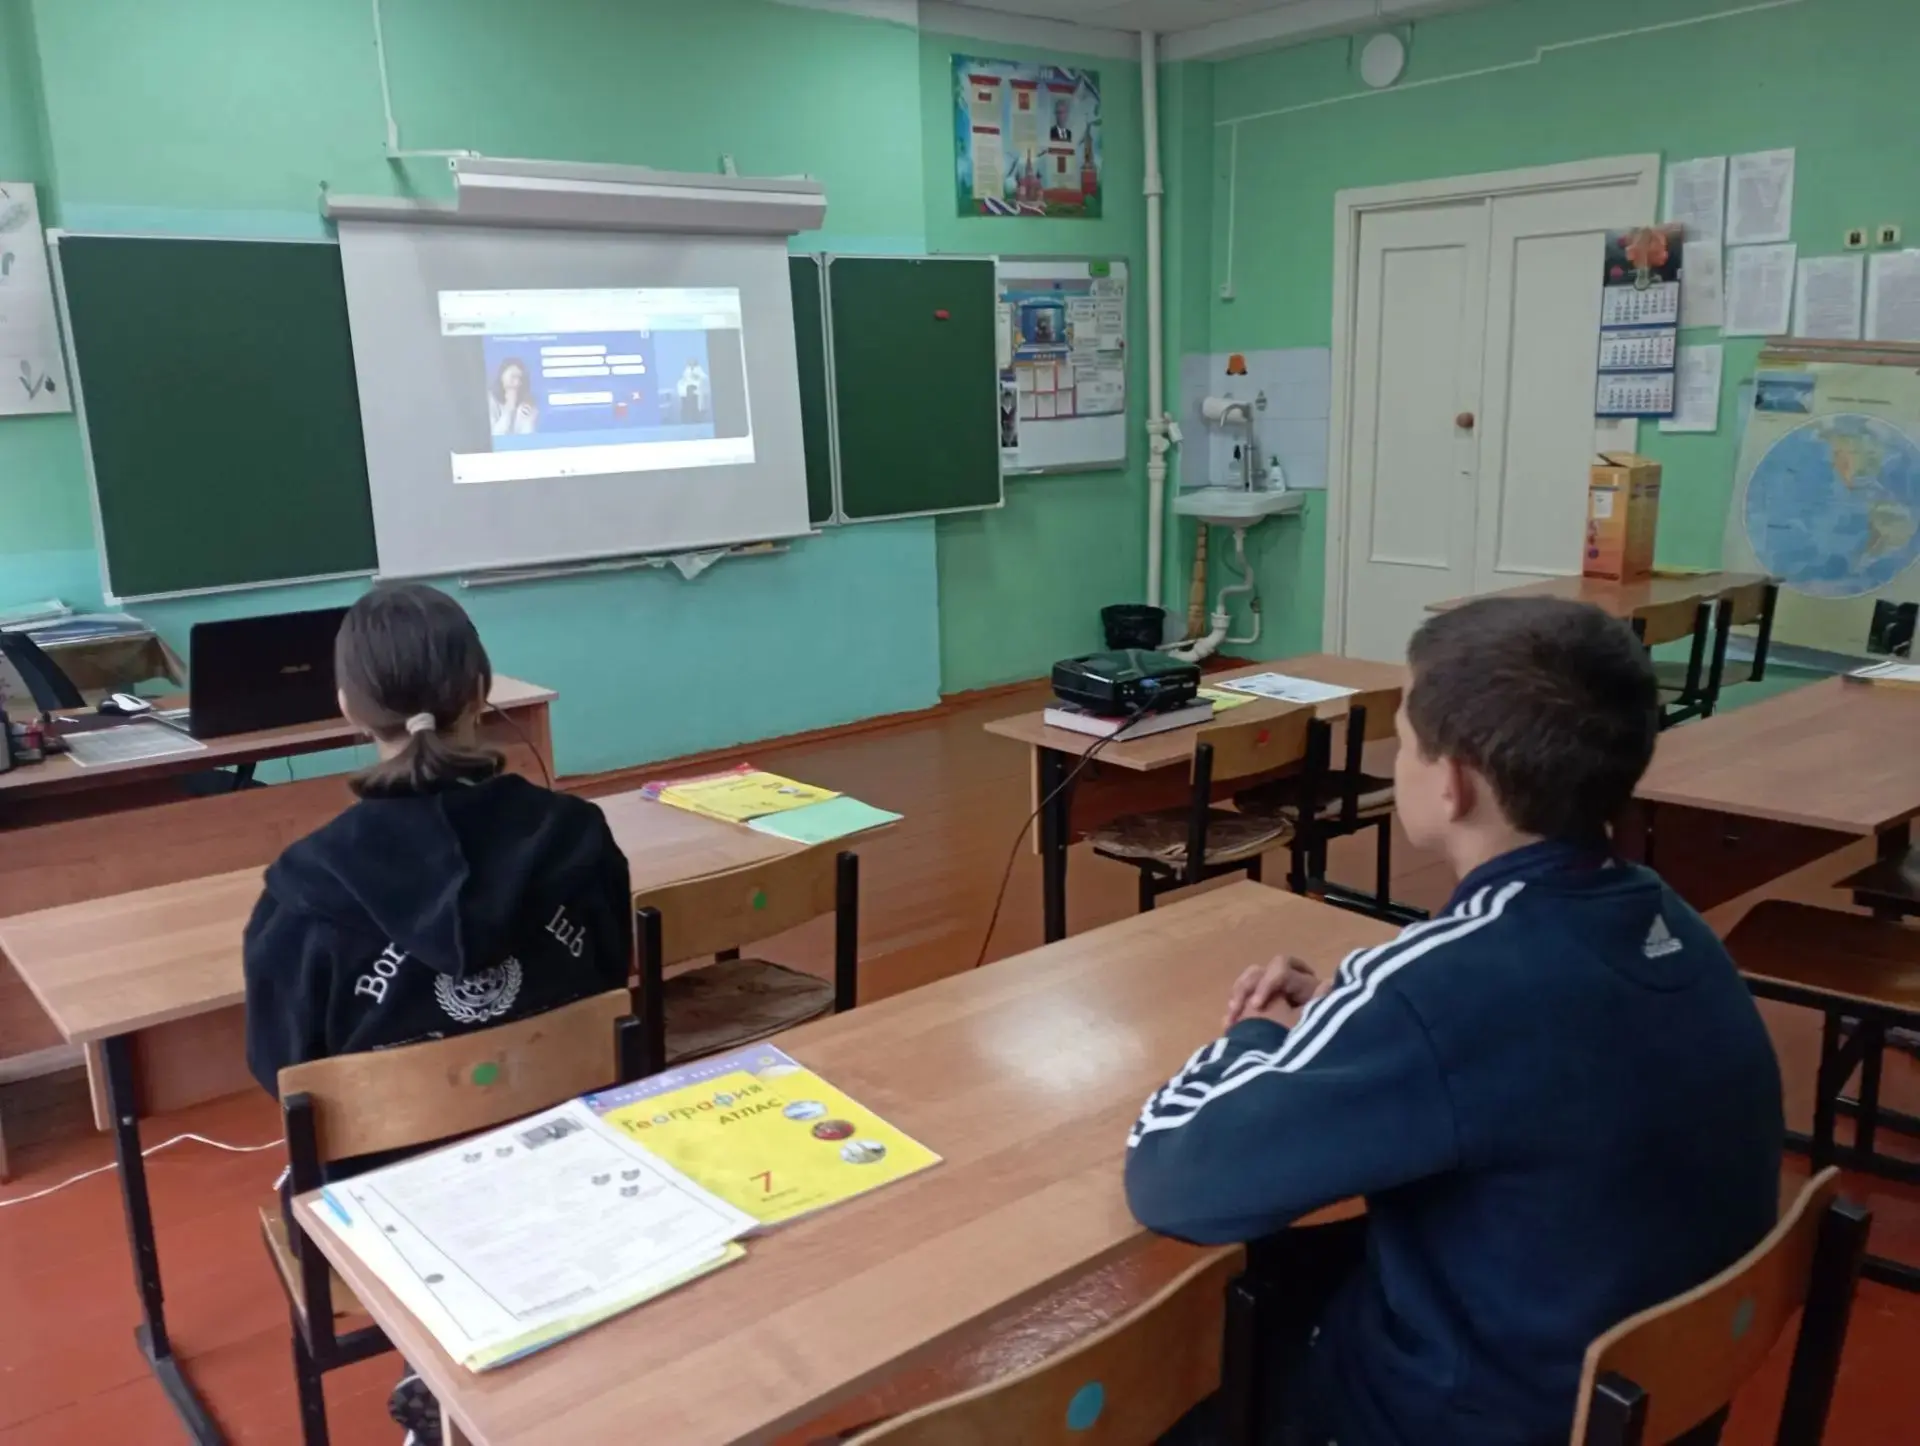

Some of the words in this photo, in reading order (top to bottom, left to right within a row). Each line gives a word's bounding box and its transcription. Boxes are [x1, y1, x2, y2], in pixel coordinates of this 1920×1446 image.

[355, 942, 409, 1005] Bor
[543, 903, 587, 958] lub
[621, 1082, 763, 1134] География
[718, 1097, 783, 1126] АТЛАС
[749, 1169, 772, 1194] 7
